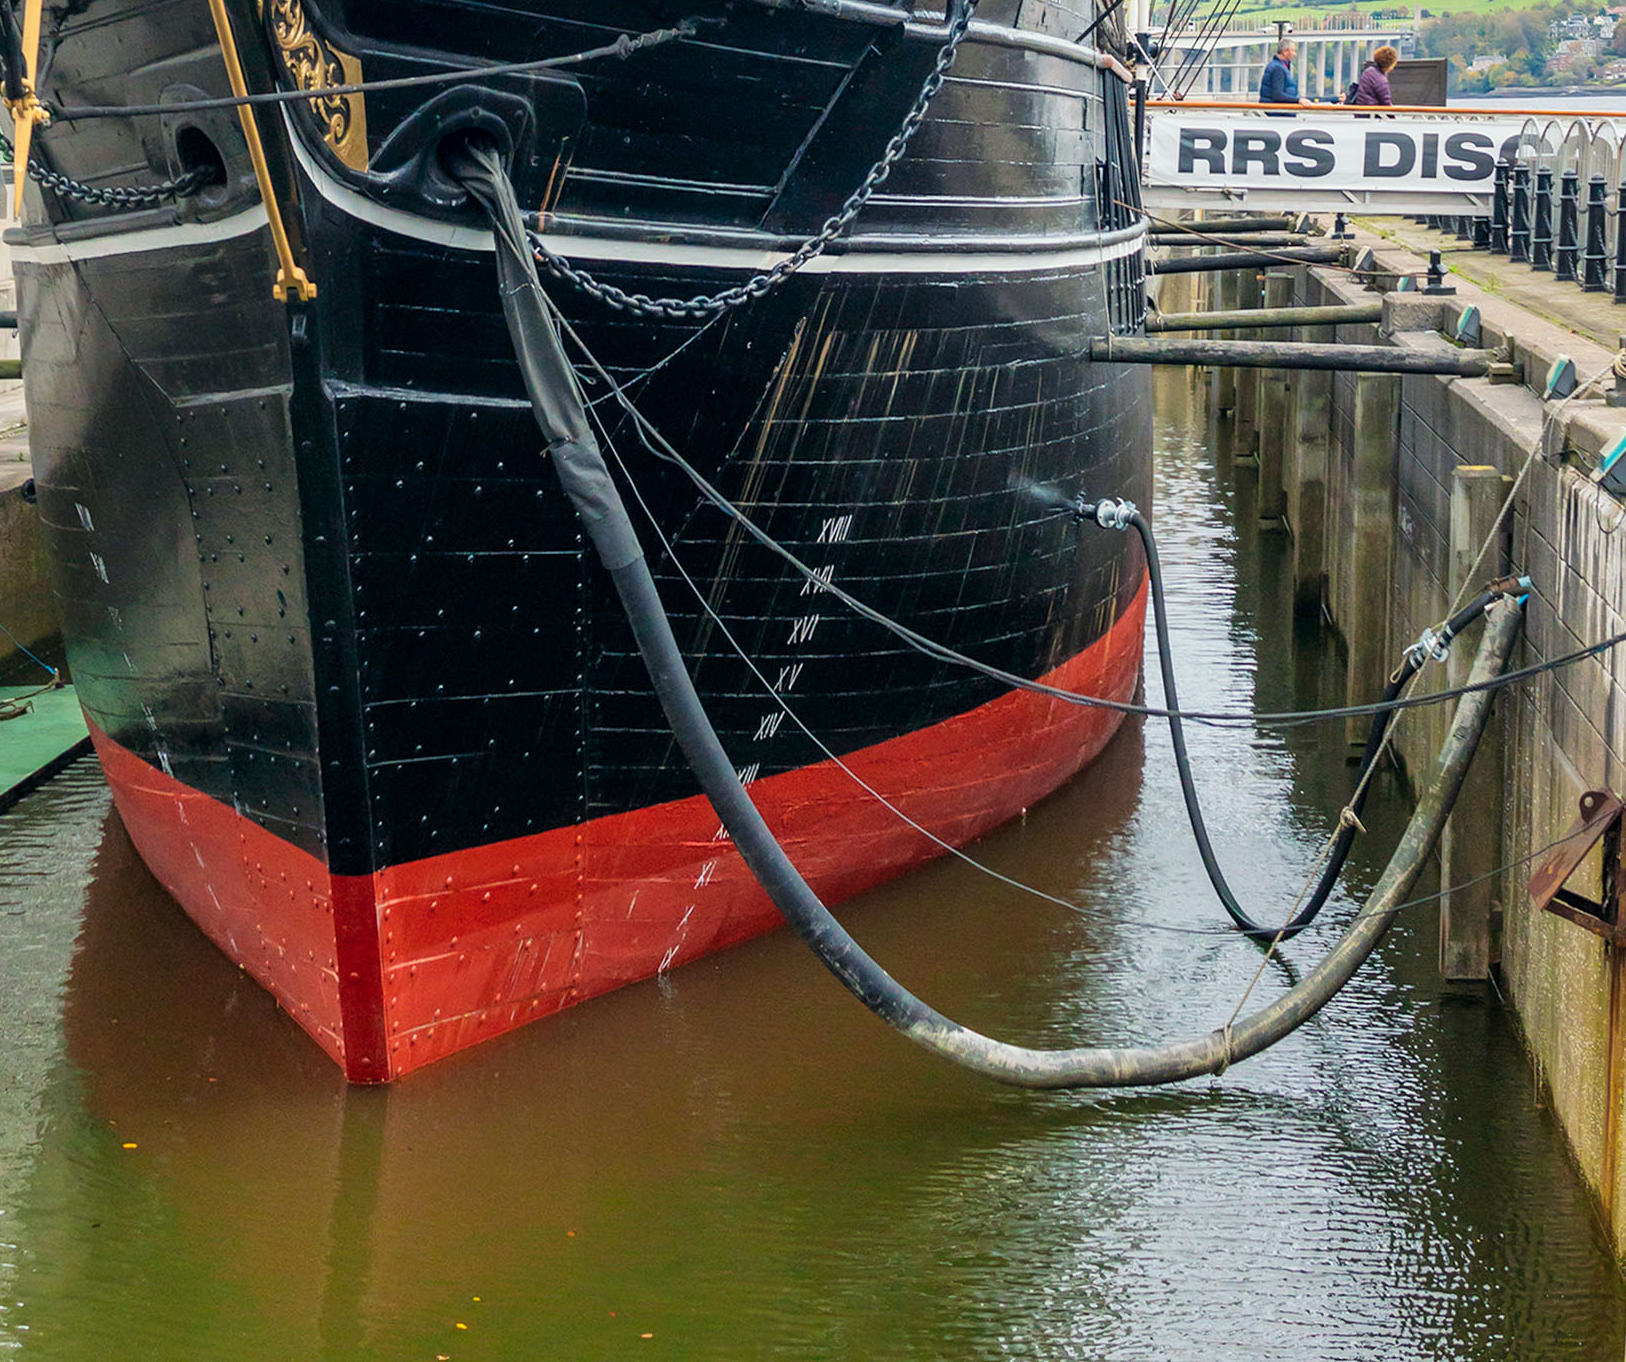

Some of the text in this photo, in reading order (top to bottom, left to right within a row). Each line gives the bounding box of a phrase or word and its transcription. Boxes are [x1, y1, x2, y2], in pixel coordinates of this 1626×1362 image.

[1177, 127, 1336, 177] RRS
[817, 514, 853, 543] XVIII
[787, 613, 820, 645] XVI
[773, 662, 804, 693] XV
[753, 710, 786, 742] XIV
